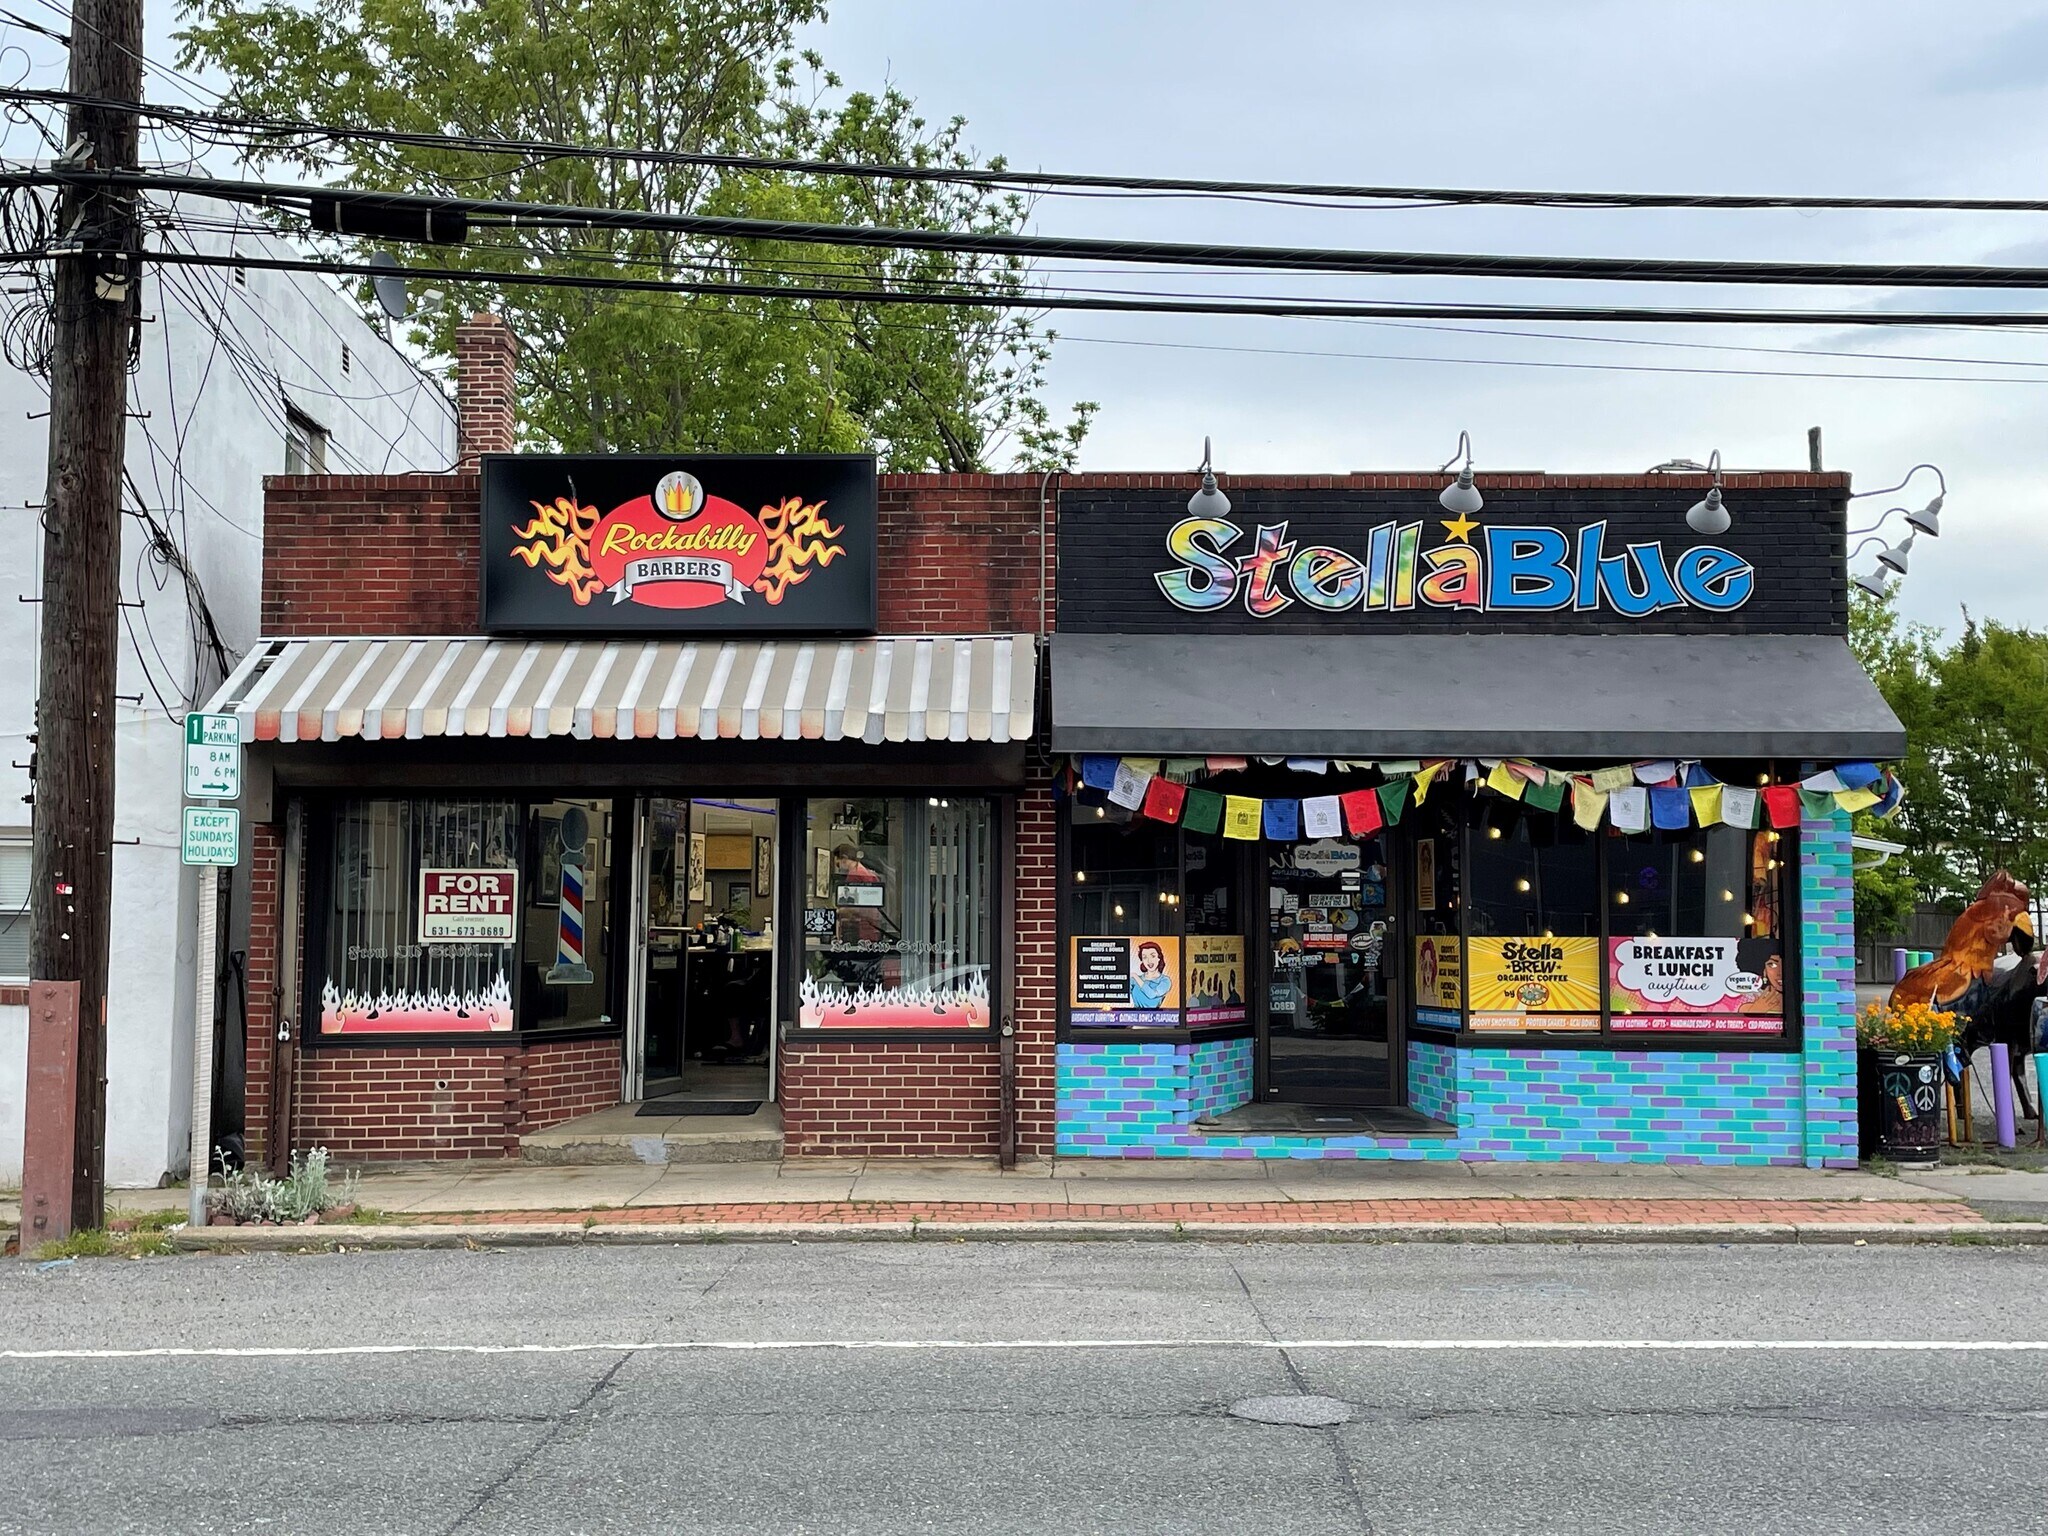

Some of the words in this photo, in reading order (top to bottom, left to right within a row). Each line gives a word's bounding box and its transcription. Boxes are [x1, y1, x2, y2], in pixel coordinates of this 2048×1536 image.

[600, 523, 758, 557] Rockabilly
[636, 561, 721, 577] BARBERS
[192, 719, 199, 740] 1
[213, 719, 228, 730] HR
[203, 731, 237, 744] PARKING
[209, 751, 217, 762] 8
[219, 752, 231, 763] AM
[189, 765, 200, 777] TO
[214, 766, 221, 777] 6
[224, 767, 236, 778] PM
[193, 816, 230, 828] EXCEPT
[189, 830, 233, 843] SUNDAYS
[187, 845, 235, 858] HOLIDAYS
[438, 875, 500, 893] FOR
[428, 894, 510, 913] RENT
[431, 926, 504, 936] 631-673-0689
[1501, 942, 1563, 961] Stella
[1633, 945, 1724, 960] BREAKFAST
[1510, 960, 1557, 974] BREW
[1644, 963, 1653, 976] &
[1658, 963, 1714, 977] LUNCH
[1497, 974, 1534, 982] ORGANIC
[1537, 974, 1568, 982] COFFEE
[1648, 977, 1710, 997] anytime
[1504, 990, 1515, 998] by
[1269, 1001, 1296, 1011] LOSED
[1652, 1019, 1666, 1028] GIFTS
[1715, 1020, 1727, 1029] DOG
